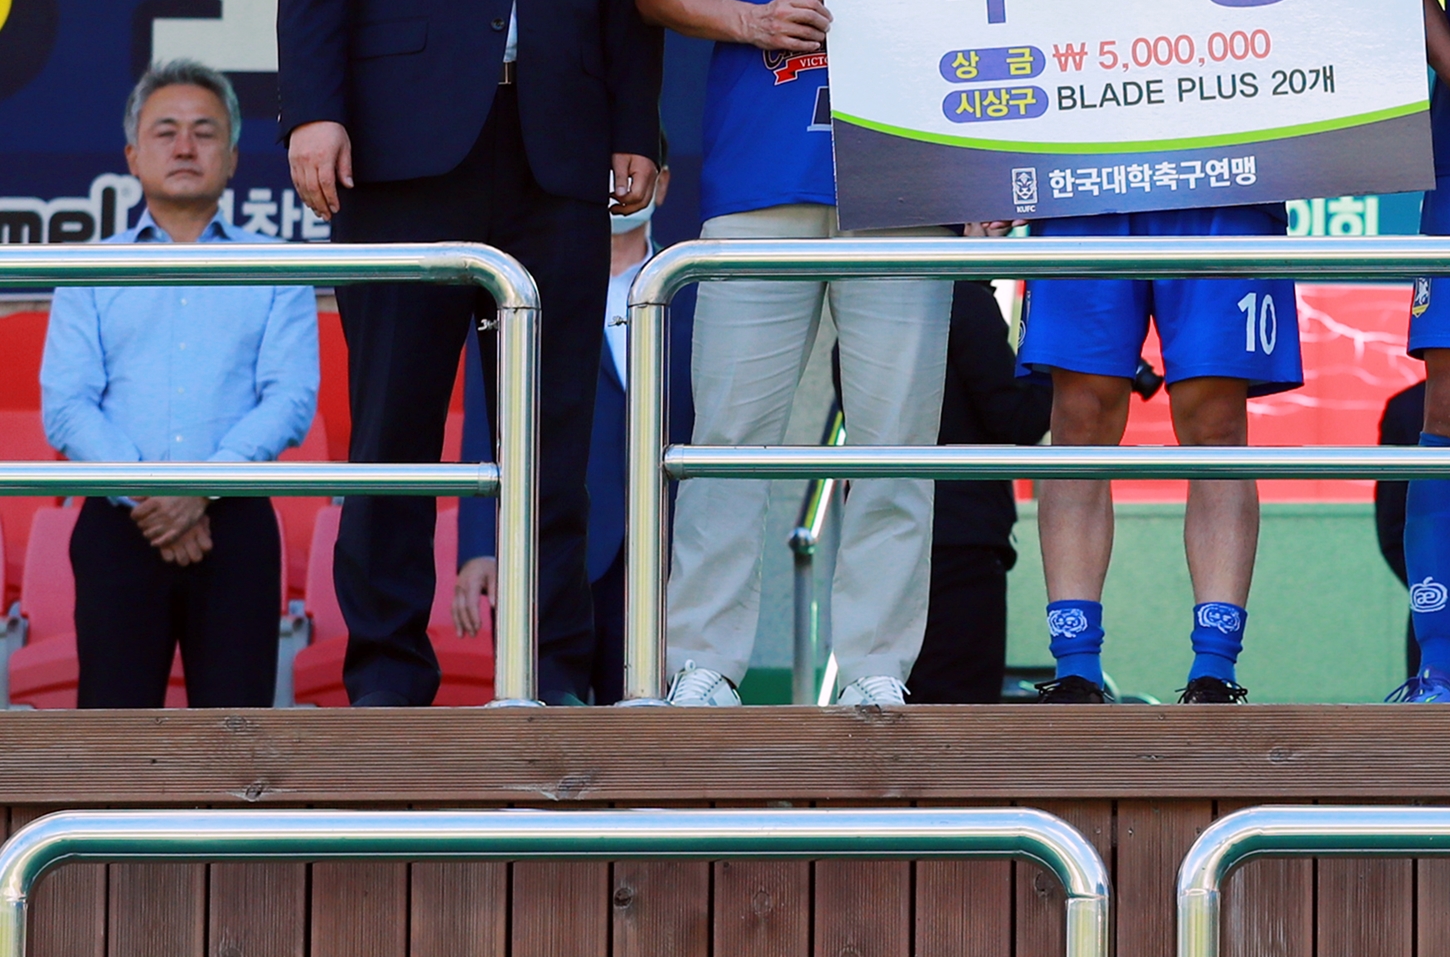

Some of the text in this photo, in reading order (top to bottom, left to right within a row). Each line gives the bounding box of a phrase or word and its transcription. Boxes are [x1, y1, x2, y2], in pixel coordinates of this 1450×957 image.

[1098, 28, 1272, 73] 5,000,000
[956, 65, 1336, 119] 시상구 BLADE PLUS 20개
[1048, 155, 1258, 198] 한국대학축구연맹
[1237, 292, 1277, 355] 10
